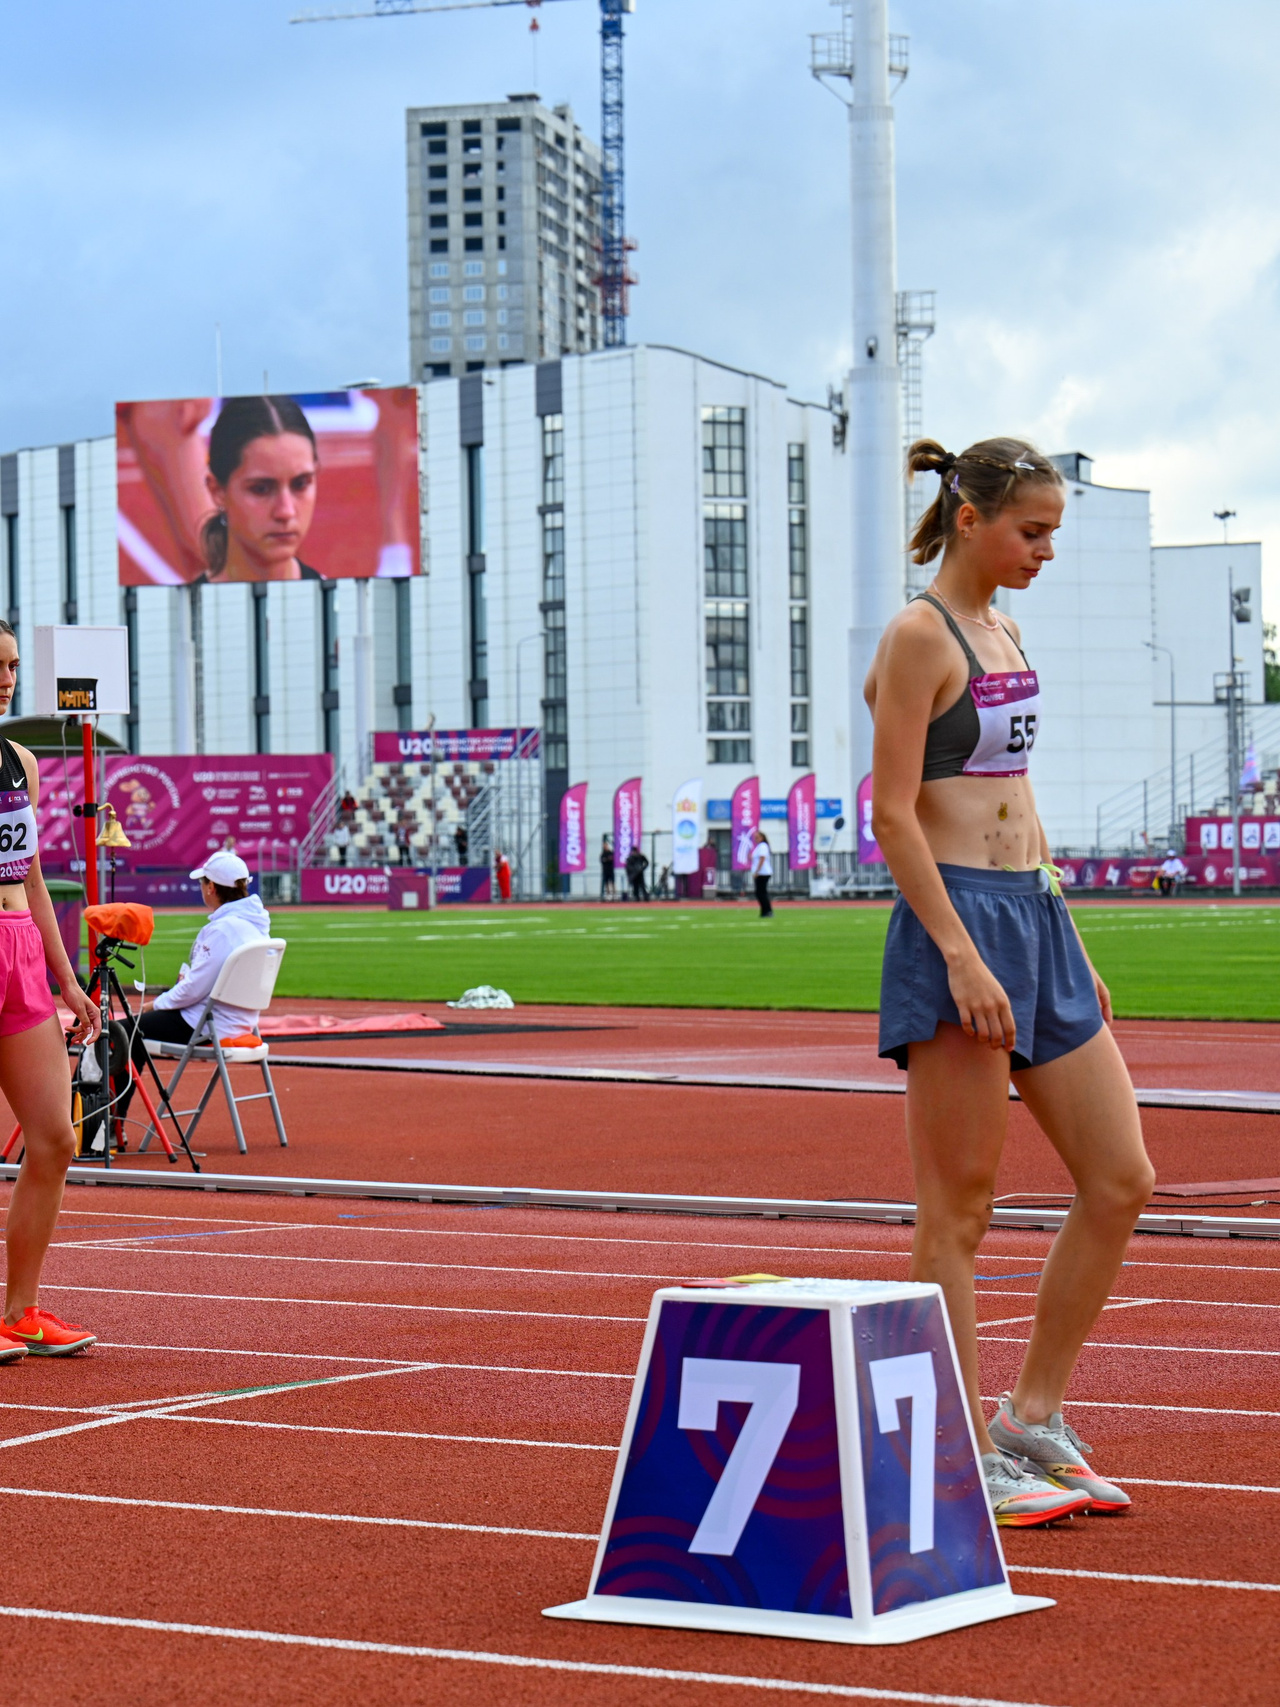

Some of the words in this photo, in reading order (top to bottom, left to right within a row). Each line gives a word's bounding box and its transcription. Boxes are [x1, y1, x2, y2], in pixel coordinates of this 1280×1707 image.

[398, 737, 433, 756] U20
[1006, 714, 1037, 754] 55
[566, 797, 581, 866] FONBET
[797, 831, 812, 865] U20
[324, 874, 366, 894] U20
[677, 1356, 801, 1557] 7
[868, 1351, 938, 1555] 7
